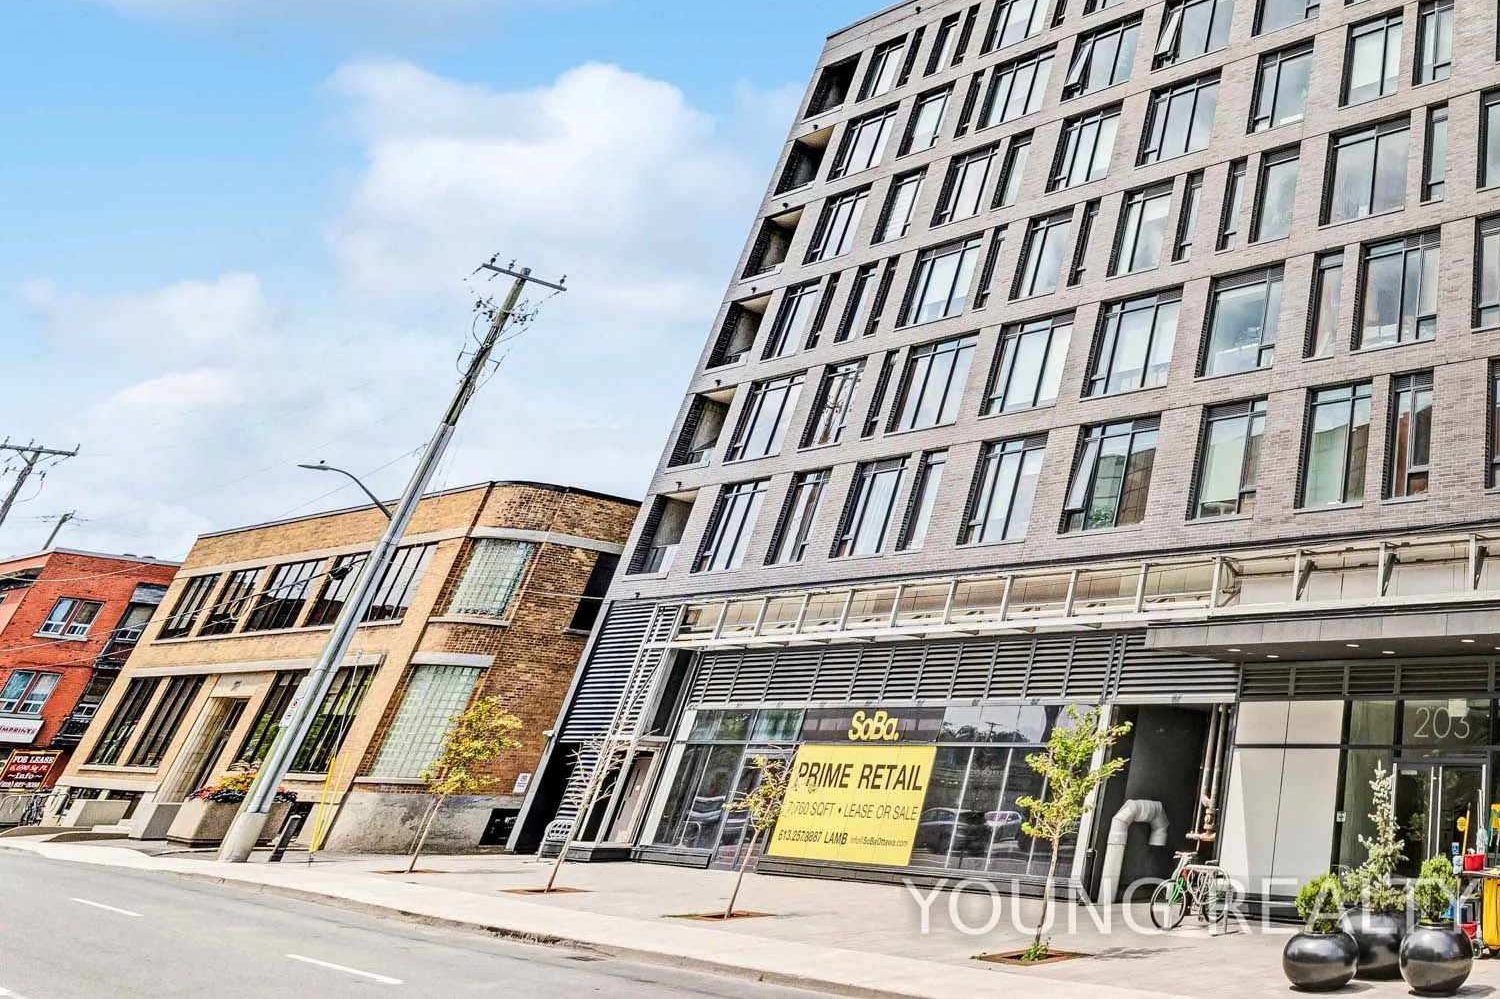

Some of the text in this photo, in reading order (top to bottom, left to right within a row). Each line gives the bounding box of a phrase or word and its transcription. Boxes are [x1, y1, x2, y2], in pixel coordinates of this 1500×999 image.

[1414, 706, 1470, 739] 203
[13, 755, 54, 764] FOR LEASE
[799, 762, 923, 791] PRIME RETAIL
[810, 801, 836, 816] SQFT
[843, 804, 874, 819] LEASE
[875, 805, 892, 819] OR
[892, 806, 918, 821] SALE
[823, 831, 849, 845] LAMB
